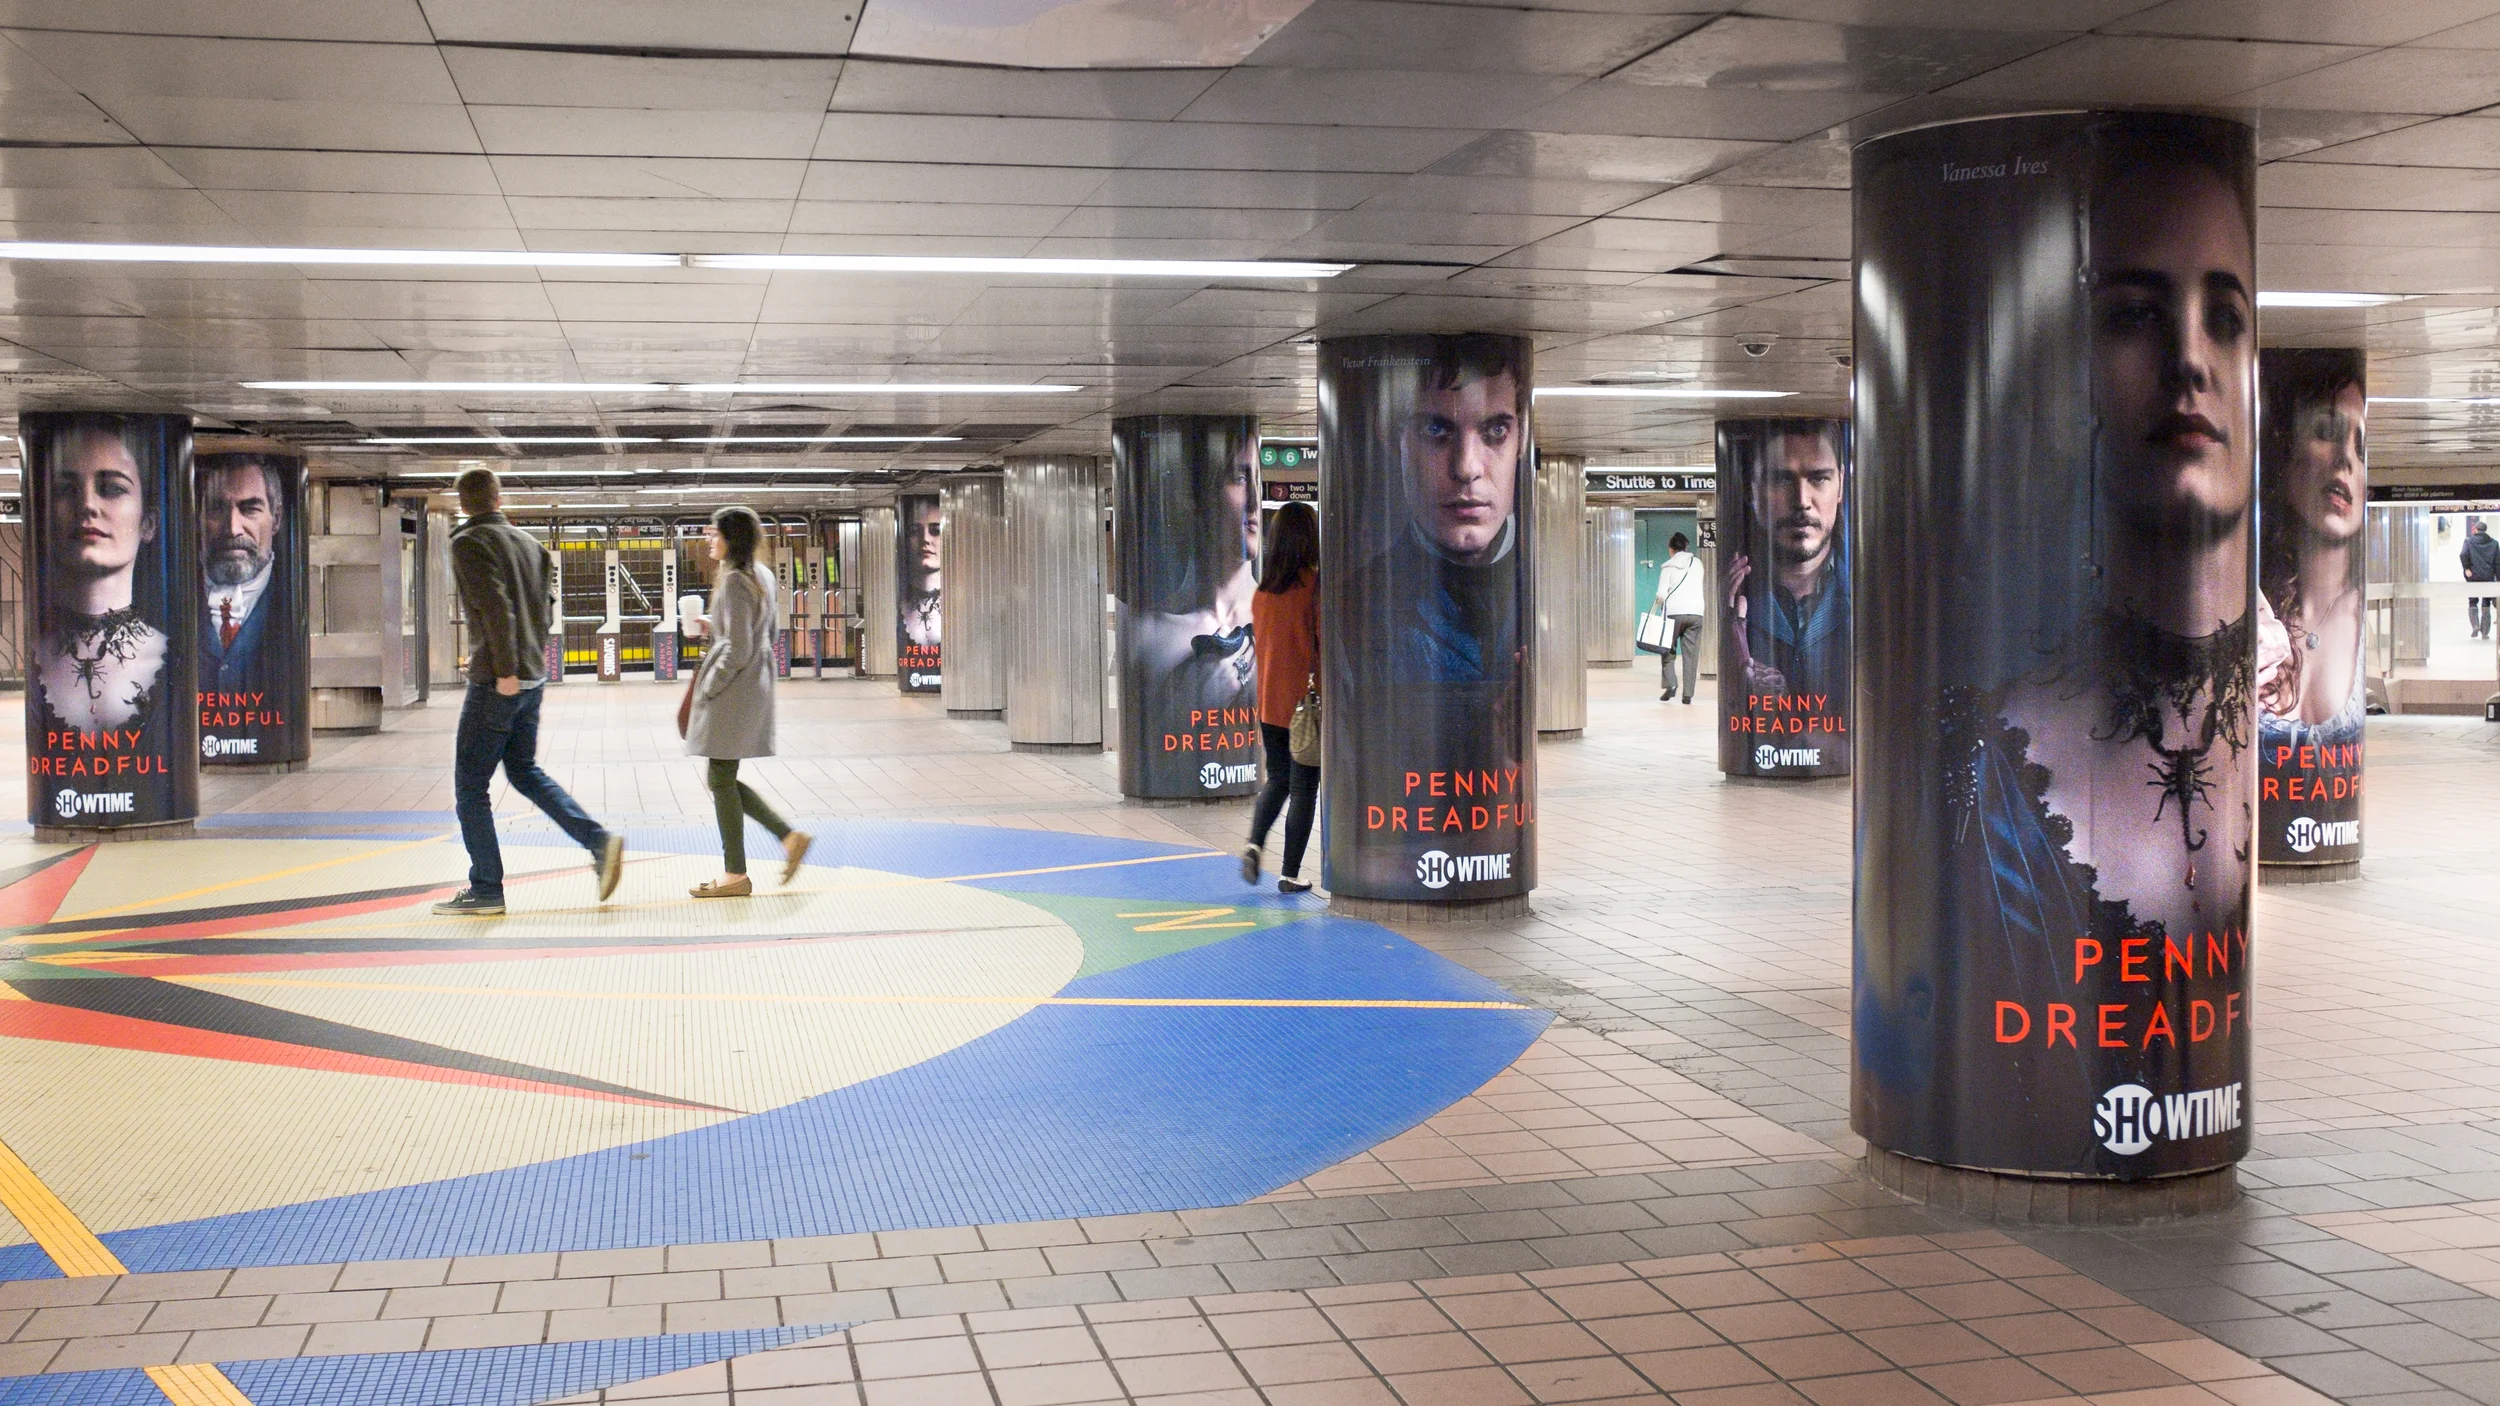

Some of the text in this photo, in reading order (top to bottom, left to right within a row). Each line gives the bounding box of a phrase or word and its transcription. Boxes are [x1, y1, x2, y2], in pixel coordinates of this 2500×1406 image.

[1941, 156, 2048, 183] Vanessa Ives
[1367, 355, 1431, 367] Frankenstein
[1264, 447, 1318, 463] 5 6 Tw
[1276, 484, 1318, 498] 7 two lev
[1606, 475, 1716, 489] Shuttle to Time
[1289, 492, 1311, 500] down
[1703, 539, 1717, 548] Squ
[551, 636, 559, 680] DREADFUL
[603, 638, 616, 676] SUNDAYS
[666, 634, 674, 678] DREADFUL
[906, 645, 939, 656] PENN
[898, 657, 942, 668] DREADF
[909, 672, 942, 687] SHOWTIM
[196, 692, 264, 708] PENNY
[1749, 694, 1827, 712] PENNY
[201, 711, 285, 727] EADFUL
[1191, 707, 1259, 728] PENNY
[1730, 716, 1846, 734] DREADFUL
[48, 729, 141, 750] PENNY
[202, 735, 258, 758] SHOWTIME
[31, 754, 168, 777] DREADFUL
[1755, 744, 1820, 770] SHOWTIME
[2277, 743, 2363, 769] PENNY
[1200, 762, 1257, 789] SHOWTIME
[1405, 767, 1519, 797] PENNY
[56, 788, 134, 818] SHOWTIME
[1367, 801, 1535, 833] DREADFUL
[2287, 816, 2360, 853] SHOWTIME
[1416, 850, 1511, 889] SHOWTIME
[2075, 926, 2249, 985] PENNY
[2094, 1082, 2242, 1156] SHOWTIME
